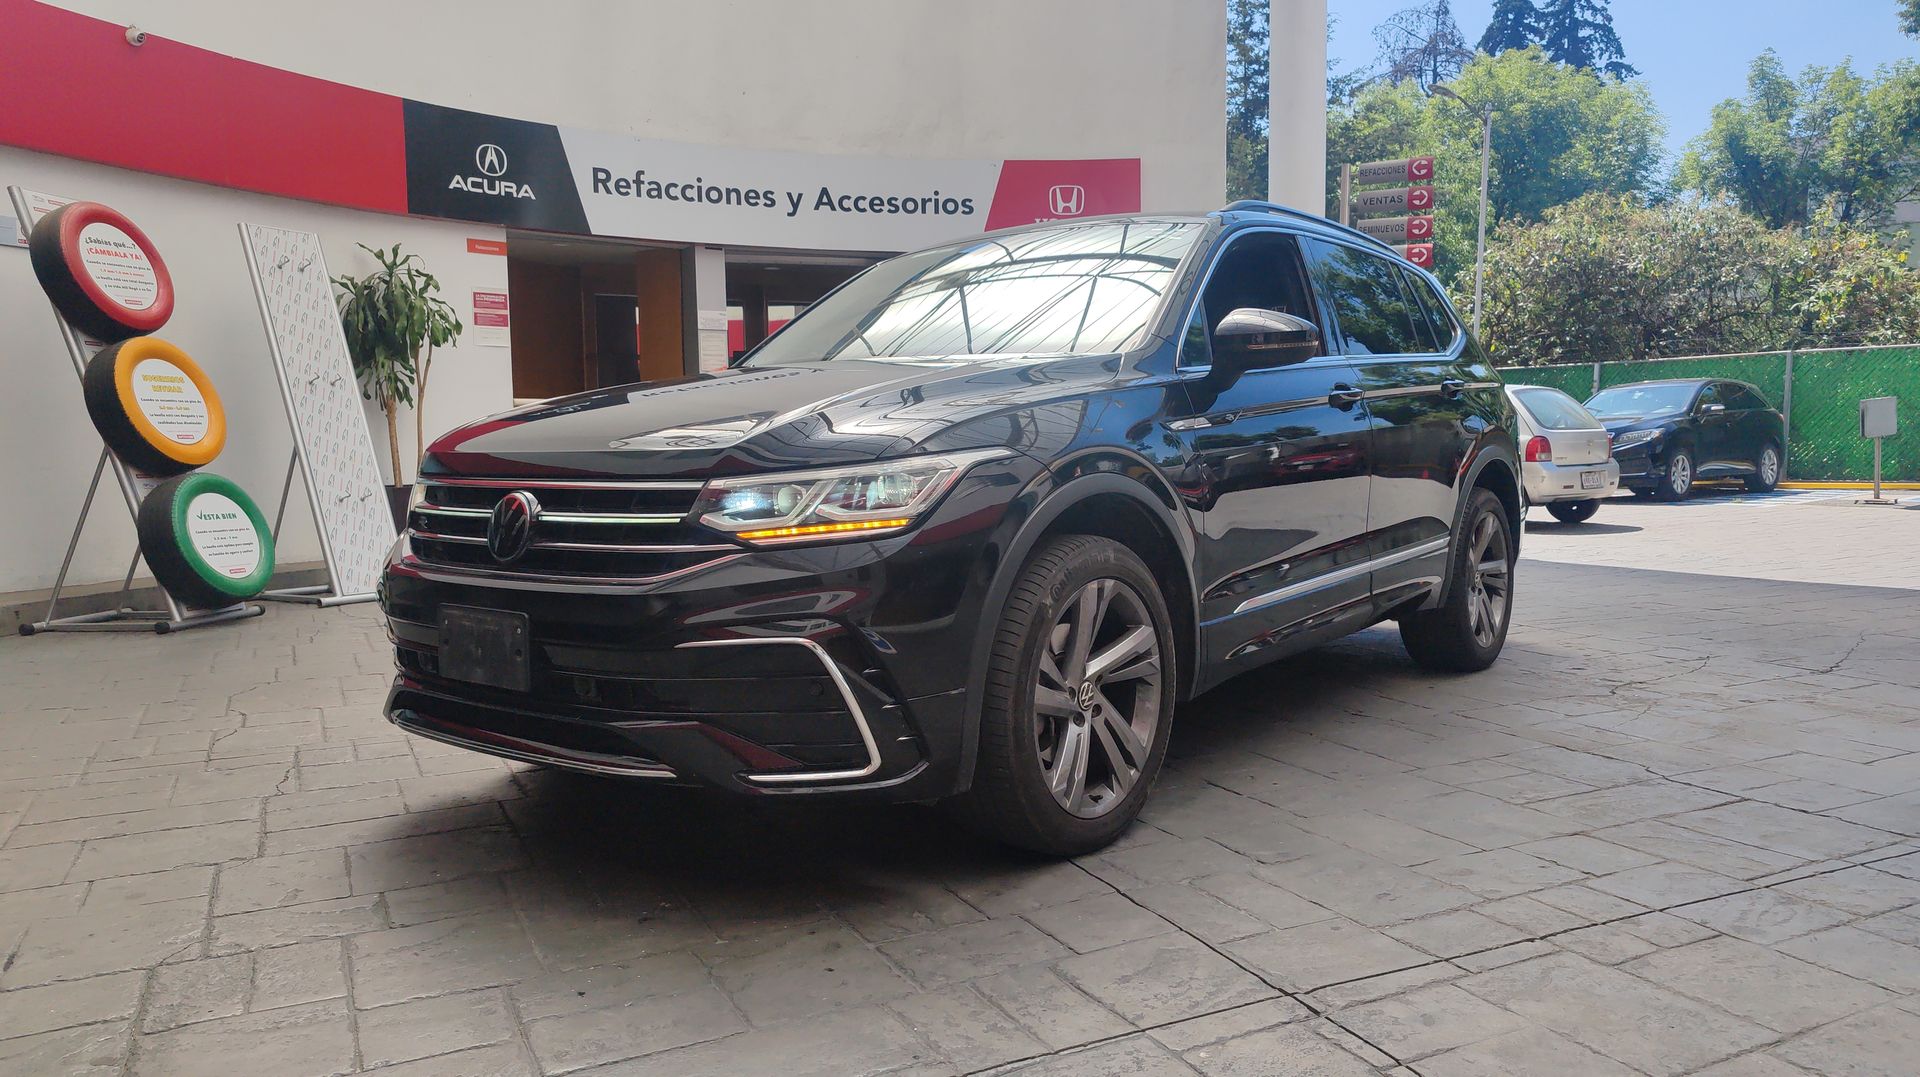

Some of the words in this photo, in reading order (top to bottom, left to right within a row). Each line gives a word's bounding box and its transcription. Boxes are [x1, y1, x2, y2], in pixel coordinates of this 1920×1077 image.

[1360, 165, 1406, 177] REFACCIONES
[448, 174, 536, 200] ACURA
[592, 167, 776, 207] Refacciones
[786, 191, 804, 217] y
[814, 187, 974, 215] Accesorios
[1362, 194, 1404, 206] VENTAS
